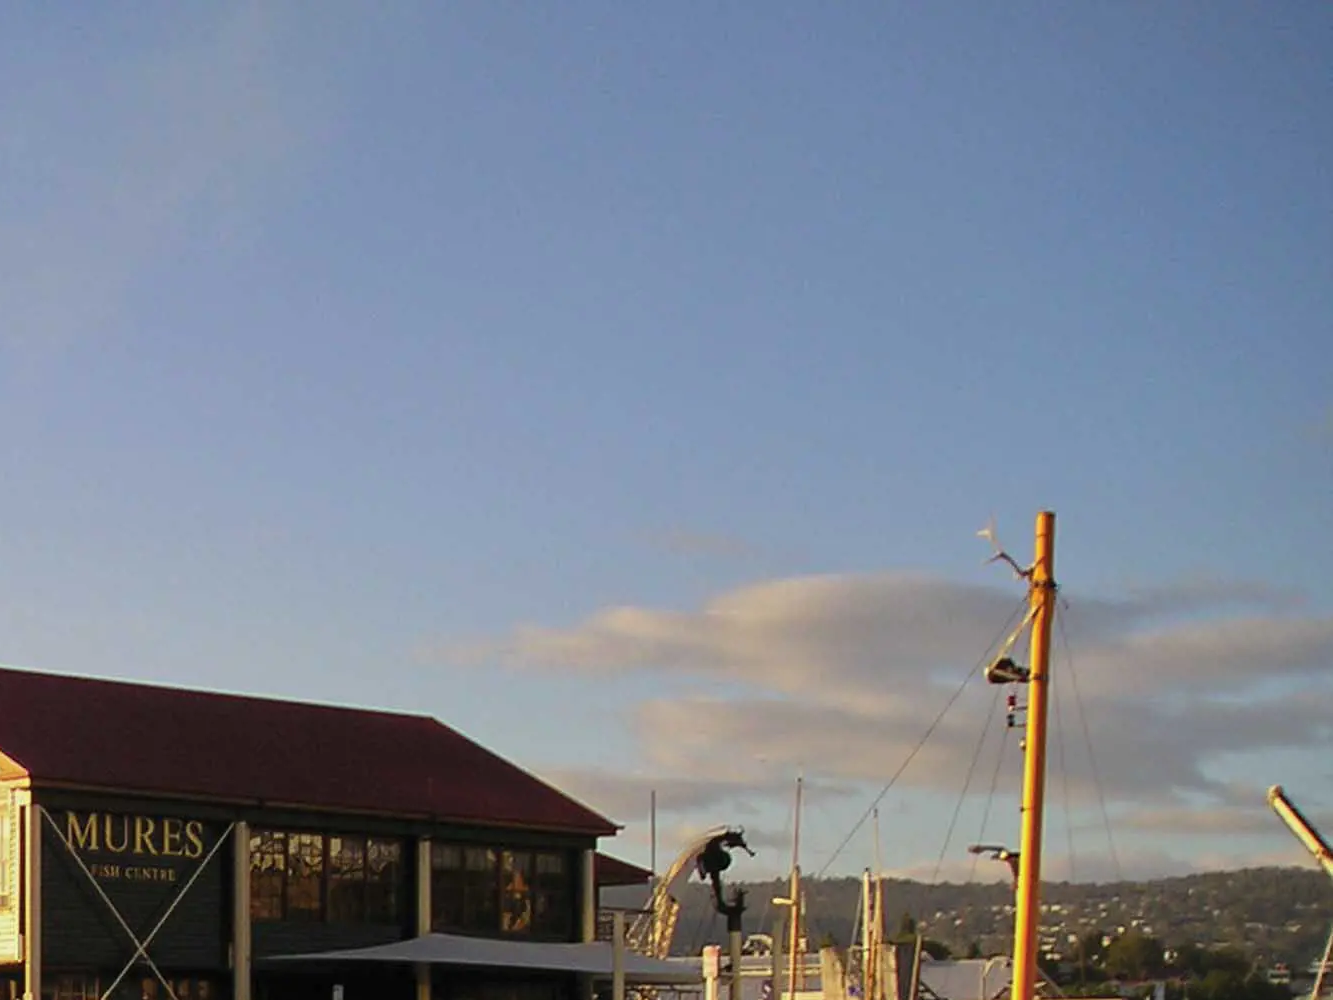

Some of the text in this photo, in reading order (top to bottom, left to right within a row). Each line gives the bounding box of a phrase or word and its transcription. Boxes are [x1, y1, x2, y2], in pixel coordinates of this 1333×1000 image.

[66, 811, 203, 859] MURES
[91, 864, 176, 882] FISH CENTRE
